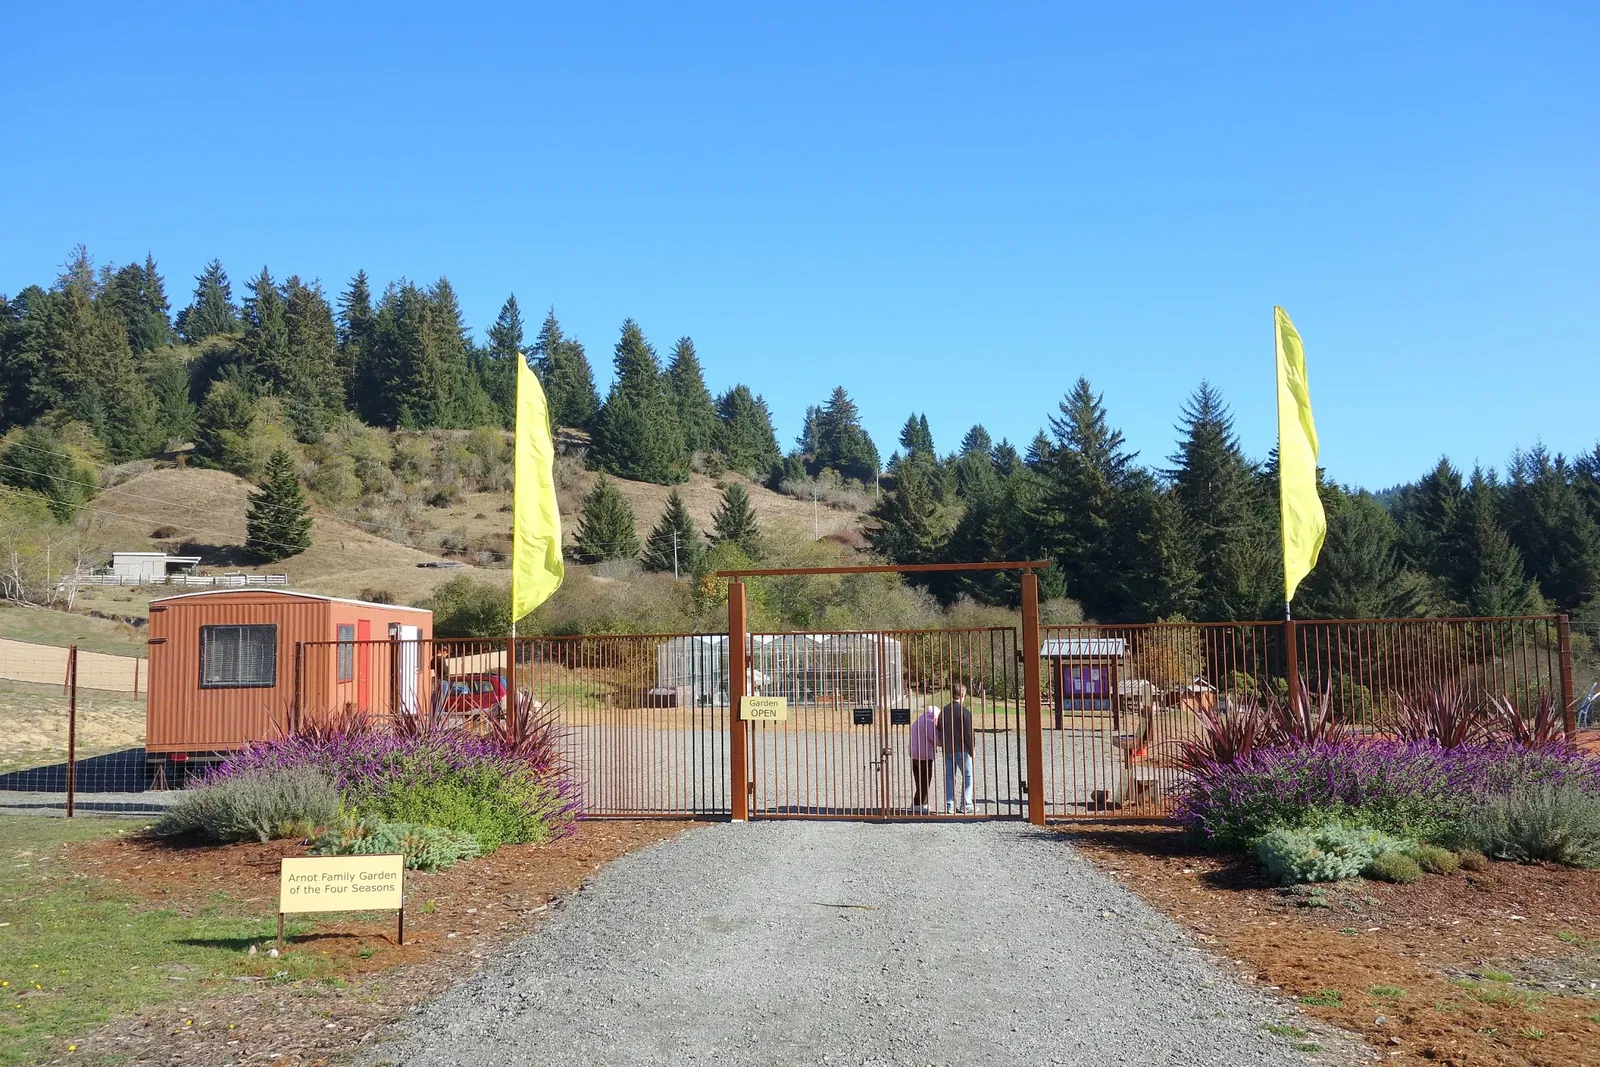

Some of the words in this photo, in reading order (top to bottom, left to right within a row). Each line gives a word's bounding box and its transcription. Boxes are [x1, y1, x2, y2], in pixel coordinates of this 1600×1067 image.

[749, 699, 779, 707] Garden
[751, 709, 777, 717] OPEN
[288, 873, 318, 882] Arnot
[321, 872, 356, 882] Family
[359, 871, 397, 881] Garden
[289, 885, 301, 895] of
[303, 885, 321, 894] the
[324, 884, 348, 894] Four
[351, 883, 395, 893] Seasons
